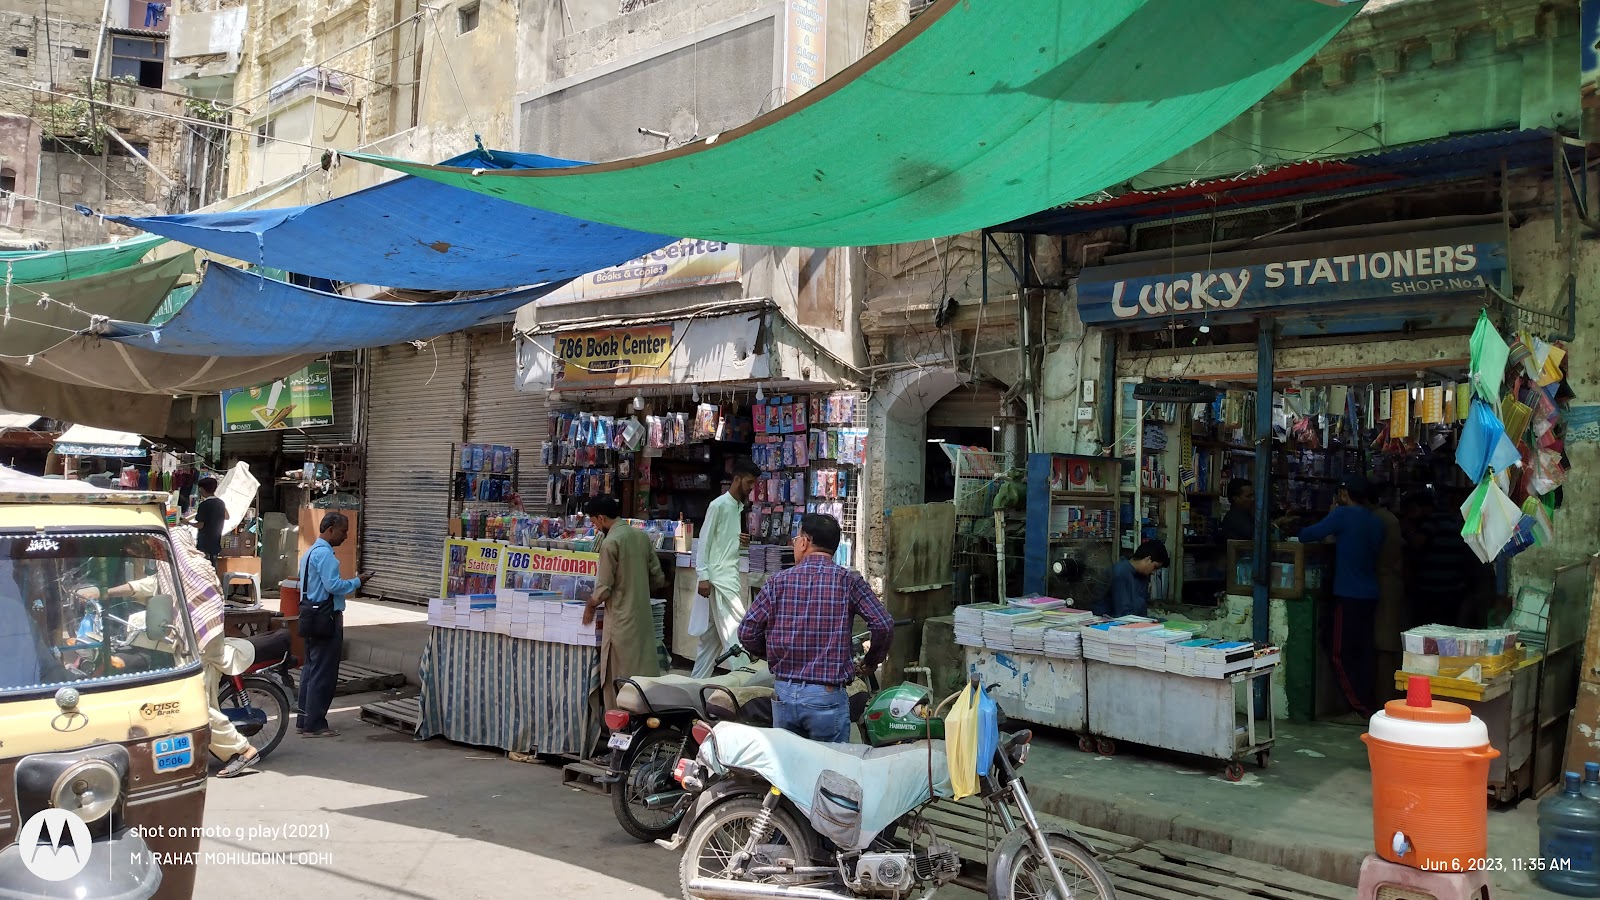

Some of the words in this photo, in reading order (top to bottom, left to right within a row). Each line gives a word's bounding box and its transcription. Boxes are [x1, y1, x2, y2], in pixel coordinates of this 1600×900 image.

[1265, 244, 1477, 288] STATIONERS
[596, 270, 621, 282] Books
[624, 271, 631, 279] &
[634, 266, 663, 279] Copies
[559, 338, 582, 358] 786
[586, 335, 618, 357] Book
[622, 334, 667, 355] Center
[480, 547, 498, 558] 786
[507, 552, 530, 569] 786
[532, 553, 598, 576] Stationary
[153, 702, 179, 711] DISC
[160, 742, 168, 751] D
[177, 738, 187, 747] 19
[159, 756, 183, 767] 0506
